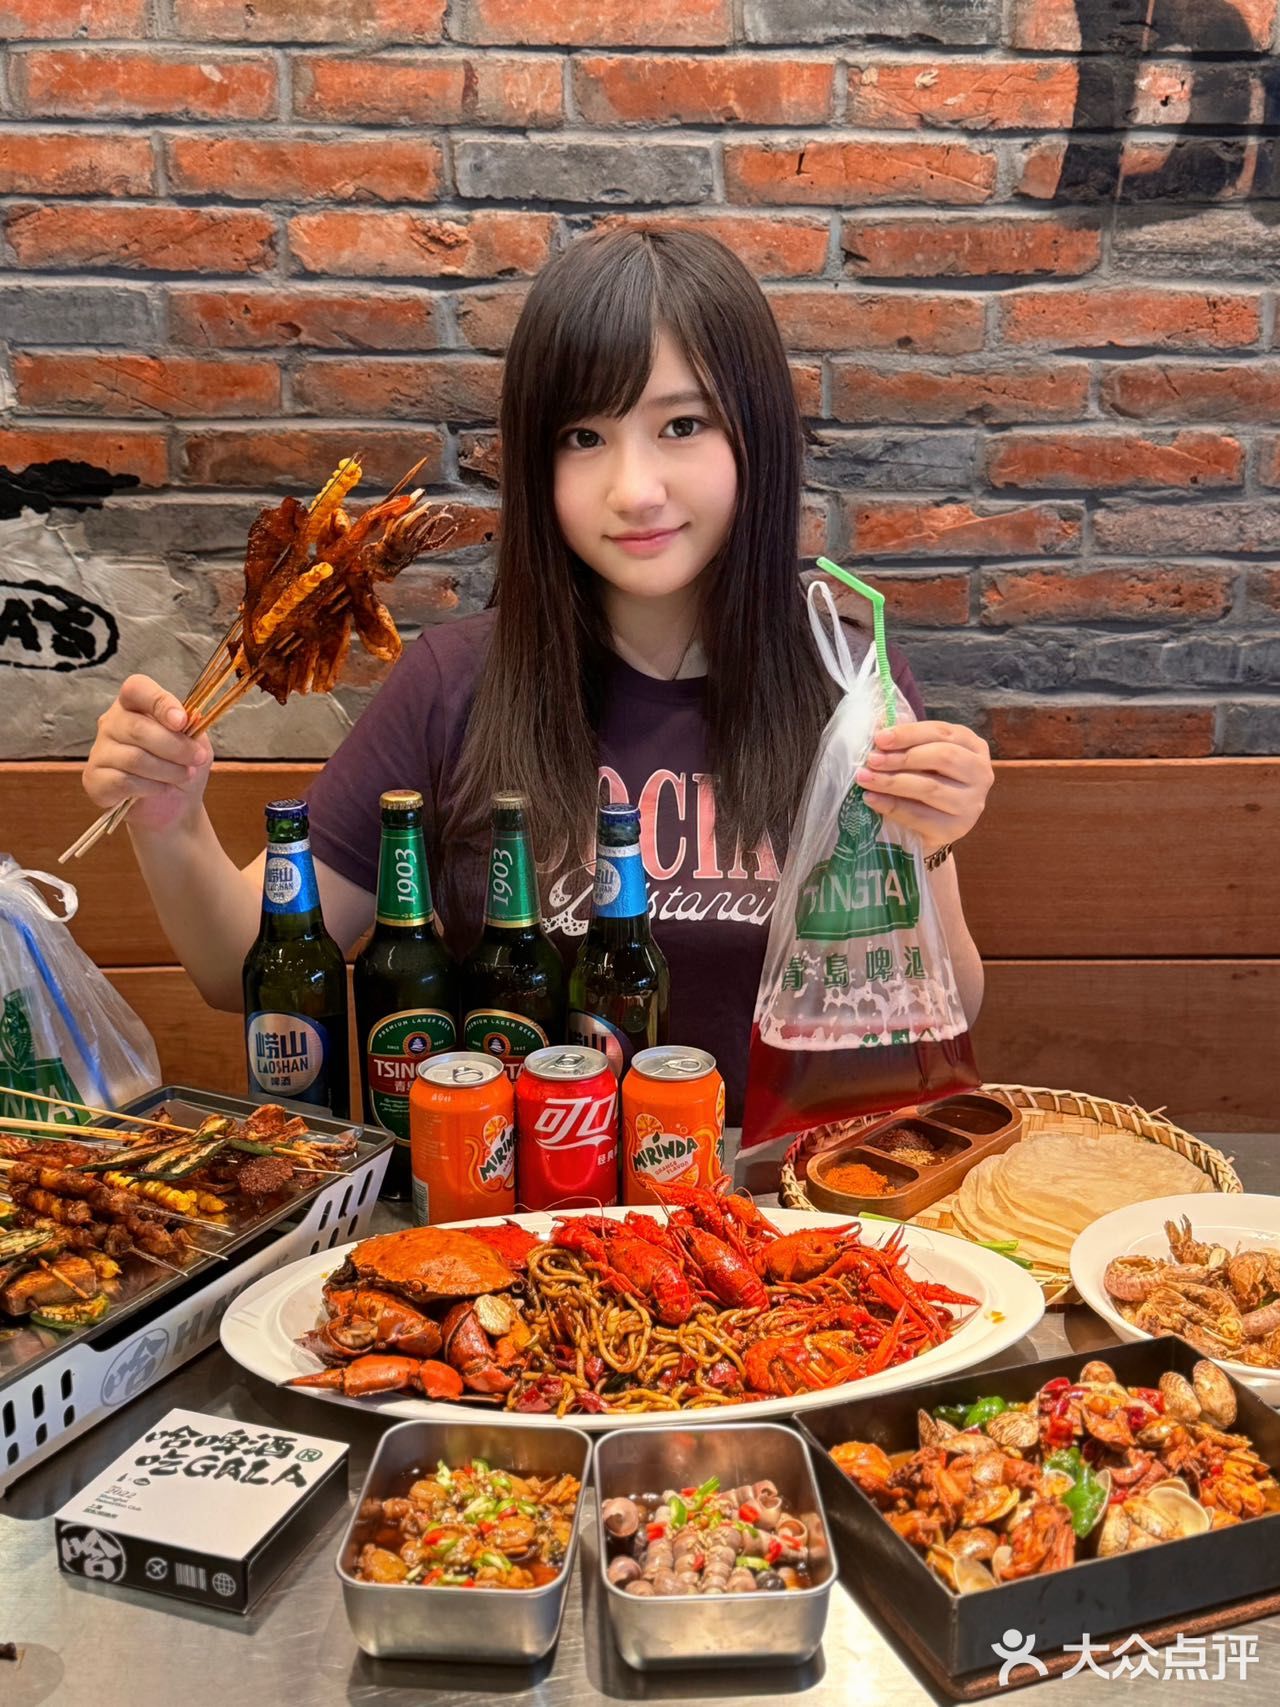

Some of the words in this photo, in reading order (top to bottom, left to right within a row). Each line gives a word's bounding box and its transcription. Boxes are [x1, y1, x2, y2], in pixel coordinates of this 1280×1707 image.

[395, 848, 419, 905] 1903
[492, 848, 513, 906] 1903
[256, 1031, 307, 1059] 崂山
[379, 1019, 408, 1037] PREMIUM
[490, 1019, 516, 1028] LAGER
[518, 1025, 536, 1039] BEER
[257, 1057, 309, 1074] LAOSHAN
[534, 1091, 618, 1144] 可口
[632, 1131, 699, 1172] MIRINDA
